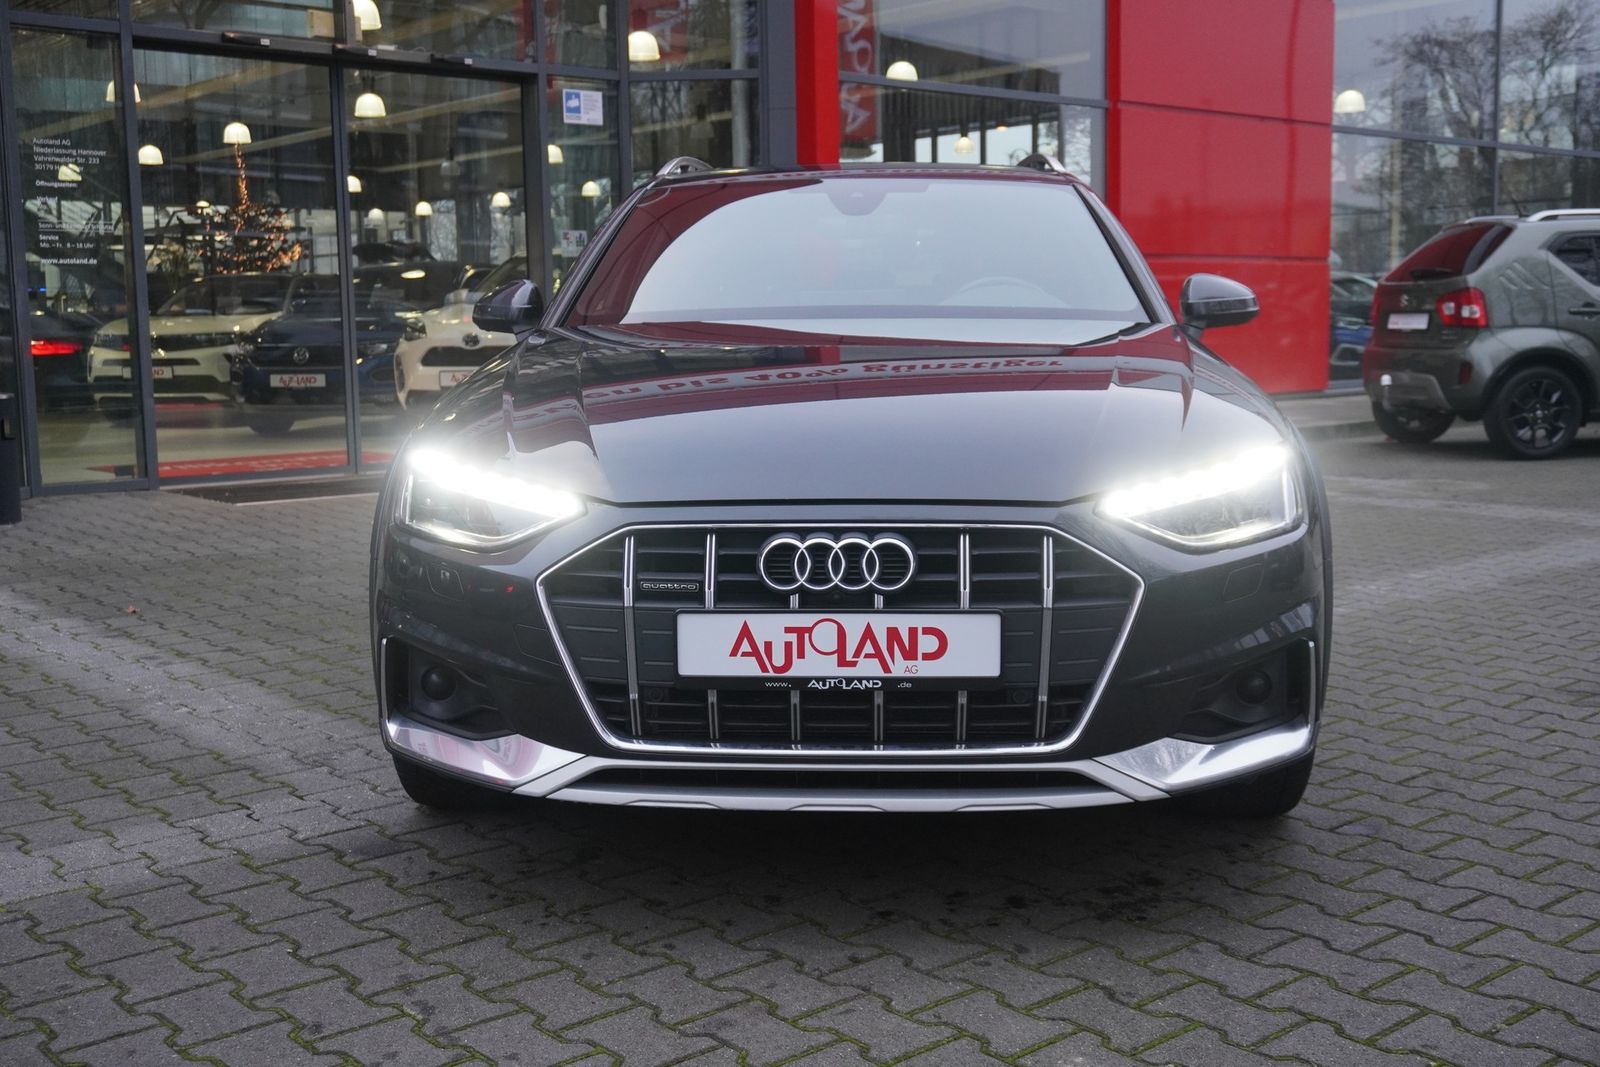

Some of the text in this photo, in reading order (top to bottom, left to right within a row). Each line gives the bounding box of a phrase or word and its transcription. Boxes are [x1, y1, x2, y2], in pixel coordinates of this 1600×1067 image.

[33, 137, 60, 146] Autoland
[33, 146, 107, 157] Niederlassung Hannover
[33, 155, 76, 164] Vahrenwalder
[88, 157, 100, 165] 233
[34, 163, 54, 171] 30179
[40, 257, 97, 265] www.autoland.de
[729, 618, 948, 674] AUTOLAND
[903, 664, 919, 674] AG
[807, 677, 882, 690] AUTOLAND
